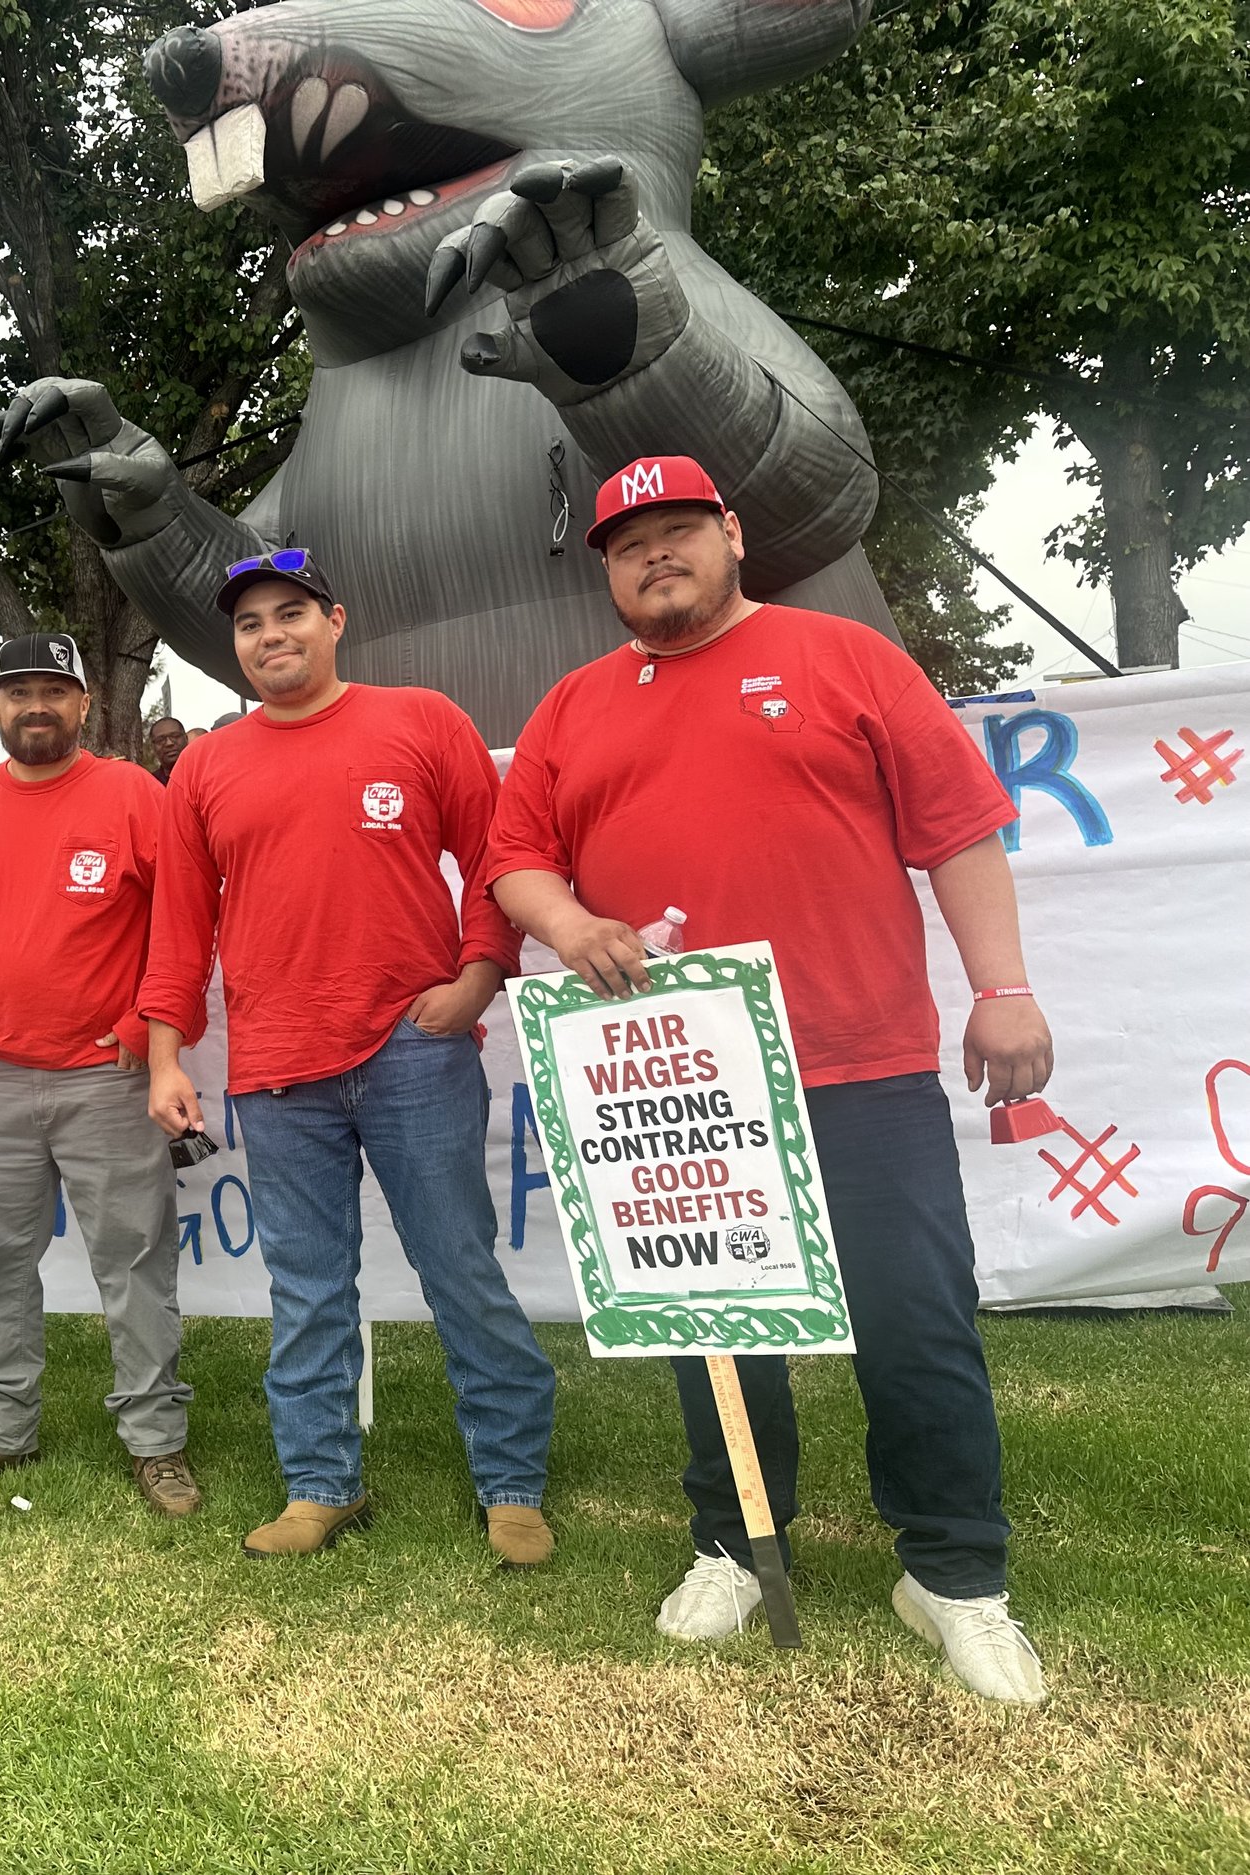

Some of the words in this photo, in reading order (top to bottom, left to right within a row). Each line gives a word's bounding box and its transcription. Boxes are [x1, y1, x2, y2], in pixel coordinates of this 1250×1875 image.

[369, 787, 398, 799] CWA
[76, 855, 102, 866] CWA
[601, 1013, 690, 1056] FAIR
[583, 1049, 719, 1096] WAGES
[595, 1089, 734, 1131] STRONG
[580, 1119, 769, 1165] CONTRACTS
[631, 1158, 730, 1194] GOOD
[611, 1189, 769, 1228] BENEFITS
[626, 1231, 718, 1269] NOW
[730, 1230, 761, 1243] CWA
[713, 1373, 729, 1409] FINEST
[721, 1411, 738, 1450] PAINTS
